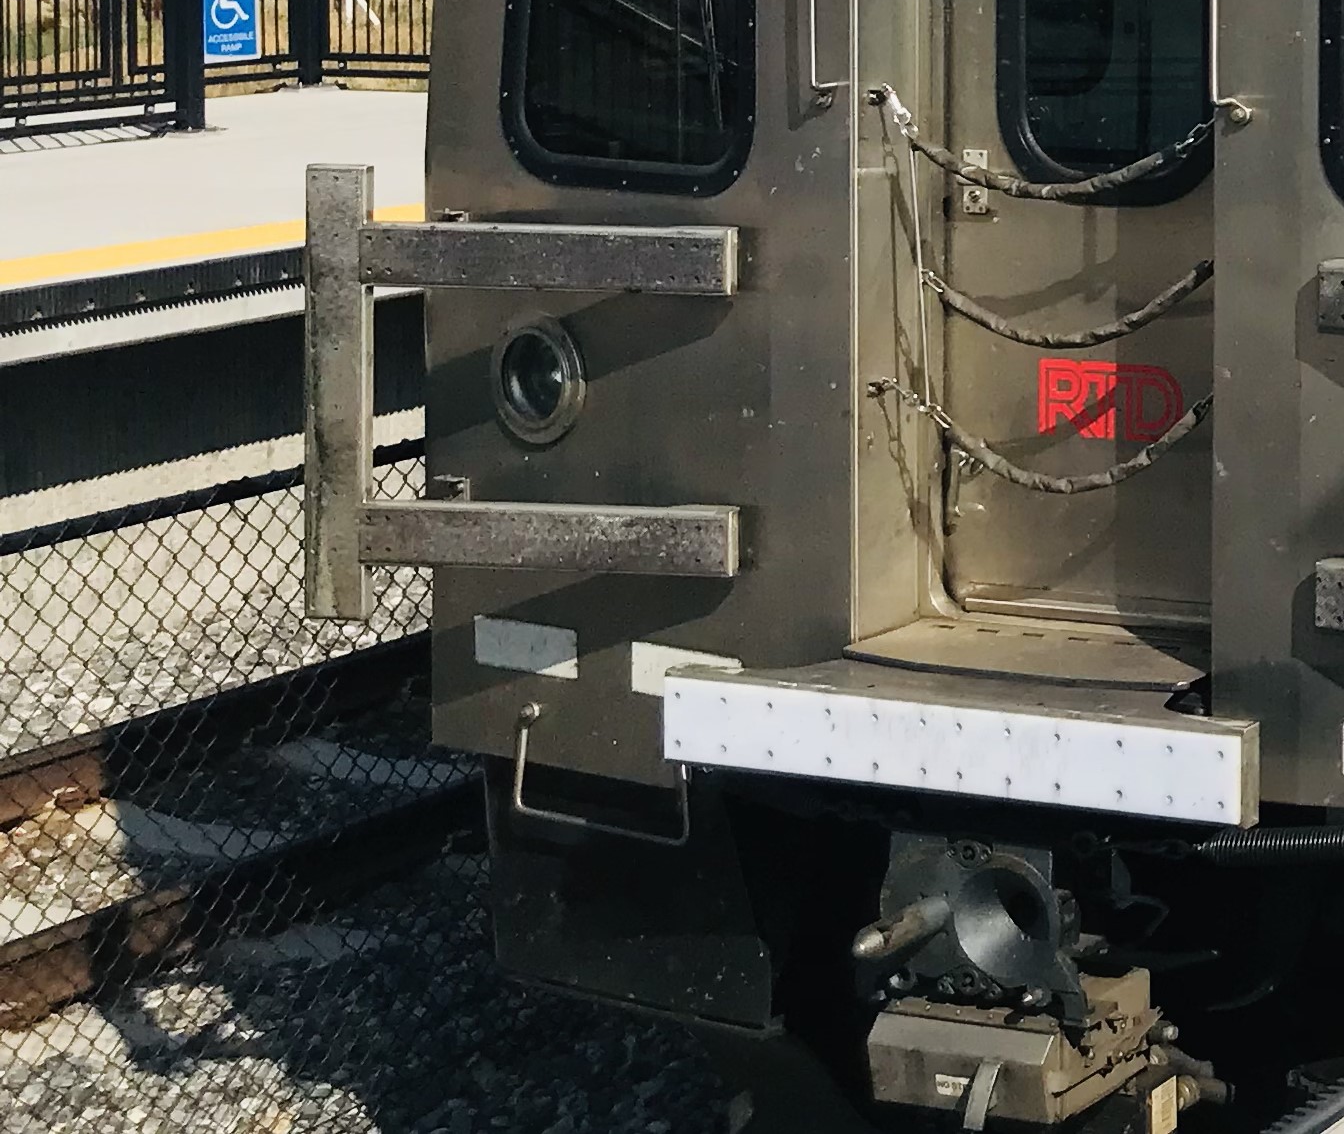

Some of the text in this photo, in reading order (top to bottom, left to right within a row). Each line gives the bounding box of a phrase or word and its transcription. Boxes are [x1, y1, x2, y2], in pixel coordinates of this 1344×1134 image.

[208, 31, 254, 44] ACCESSIBLE
[220, 43, 243, 52] RAMP
[1037, 357, 1184, 443] RTD
